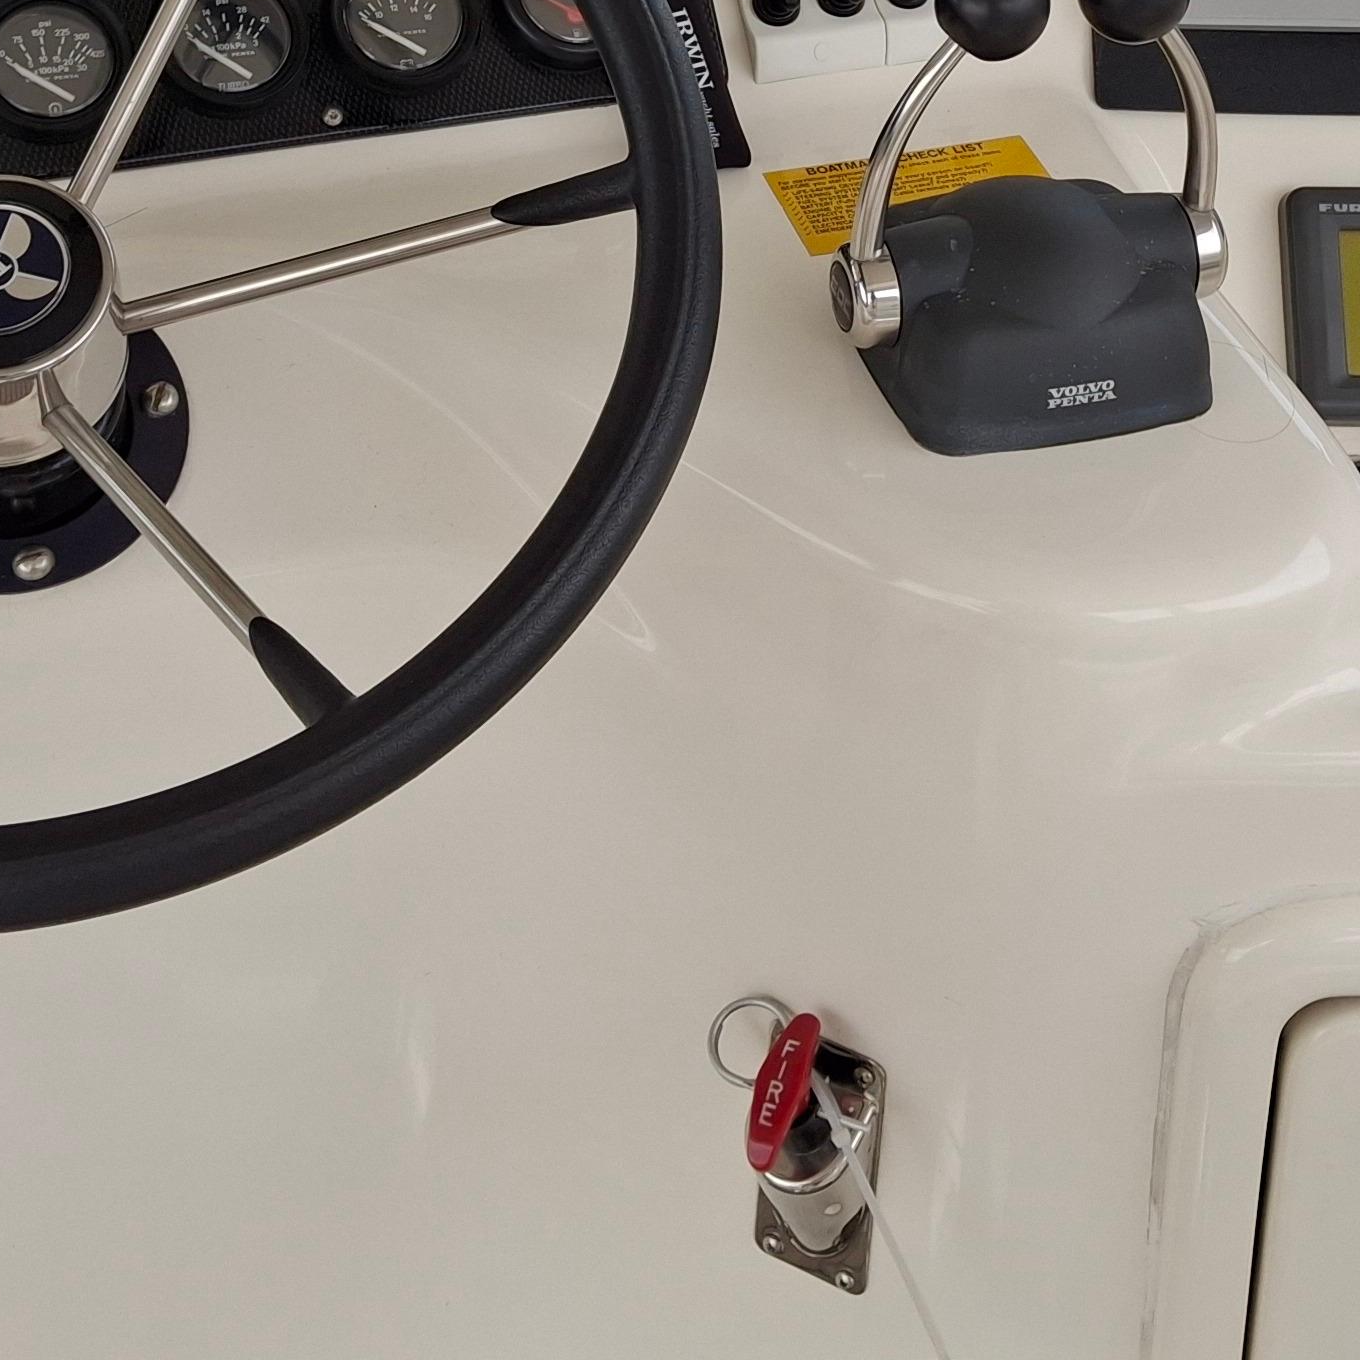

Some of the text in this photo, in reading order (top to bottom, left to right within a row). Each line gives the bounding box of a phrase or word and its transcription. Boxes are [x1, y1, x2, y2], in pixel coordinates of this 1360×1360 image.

[236, 6, 247, 14] 28
[390, 4, 398, 12] 12
[375, 11, 383, 19] 10
[54, 28, 70, 36] 225
[73, 33, 90, 41] 300
[672, 6, 715, 90] IRWIN
[805, 142, 984, 176] BOATMA CHECK LIST
[1048, 380, 1115, 398] VOLVO
[1047, 391, 1117, 409] PENTA
[758, 1039, 802, 1127] FIRE
